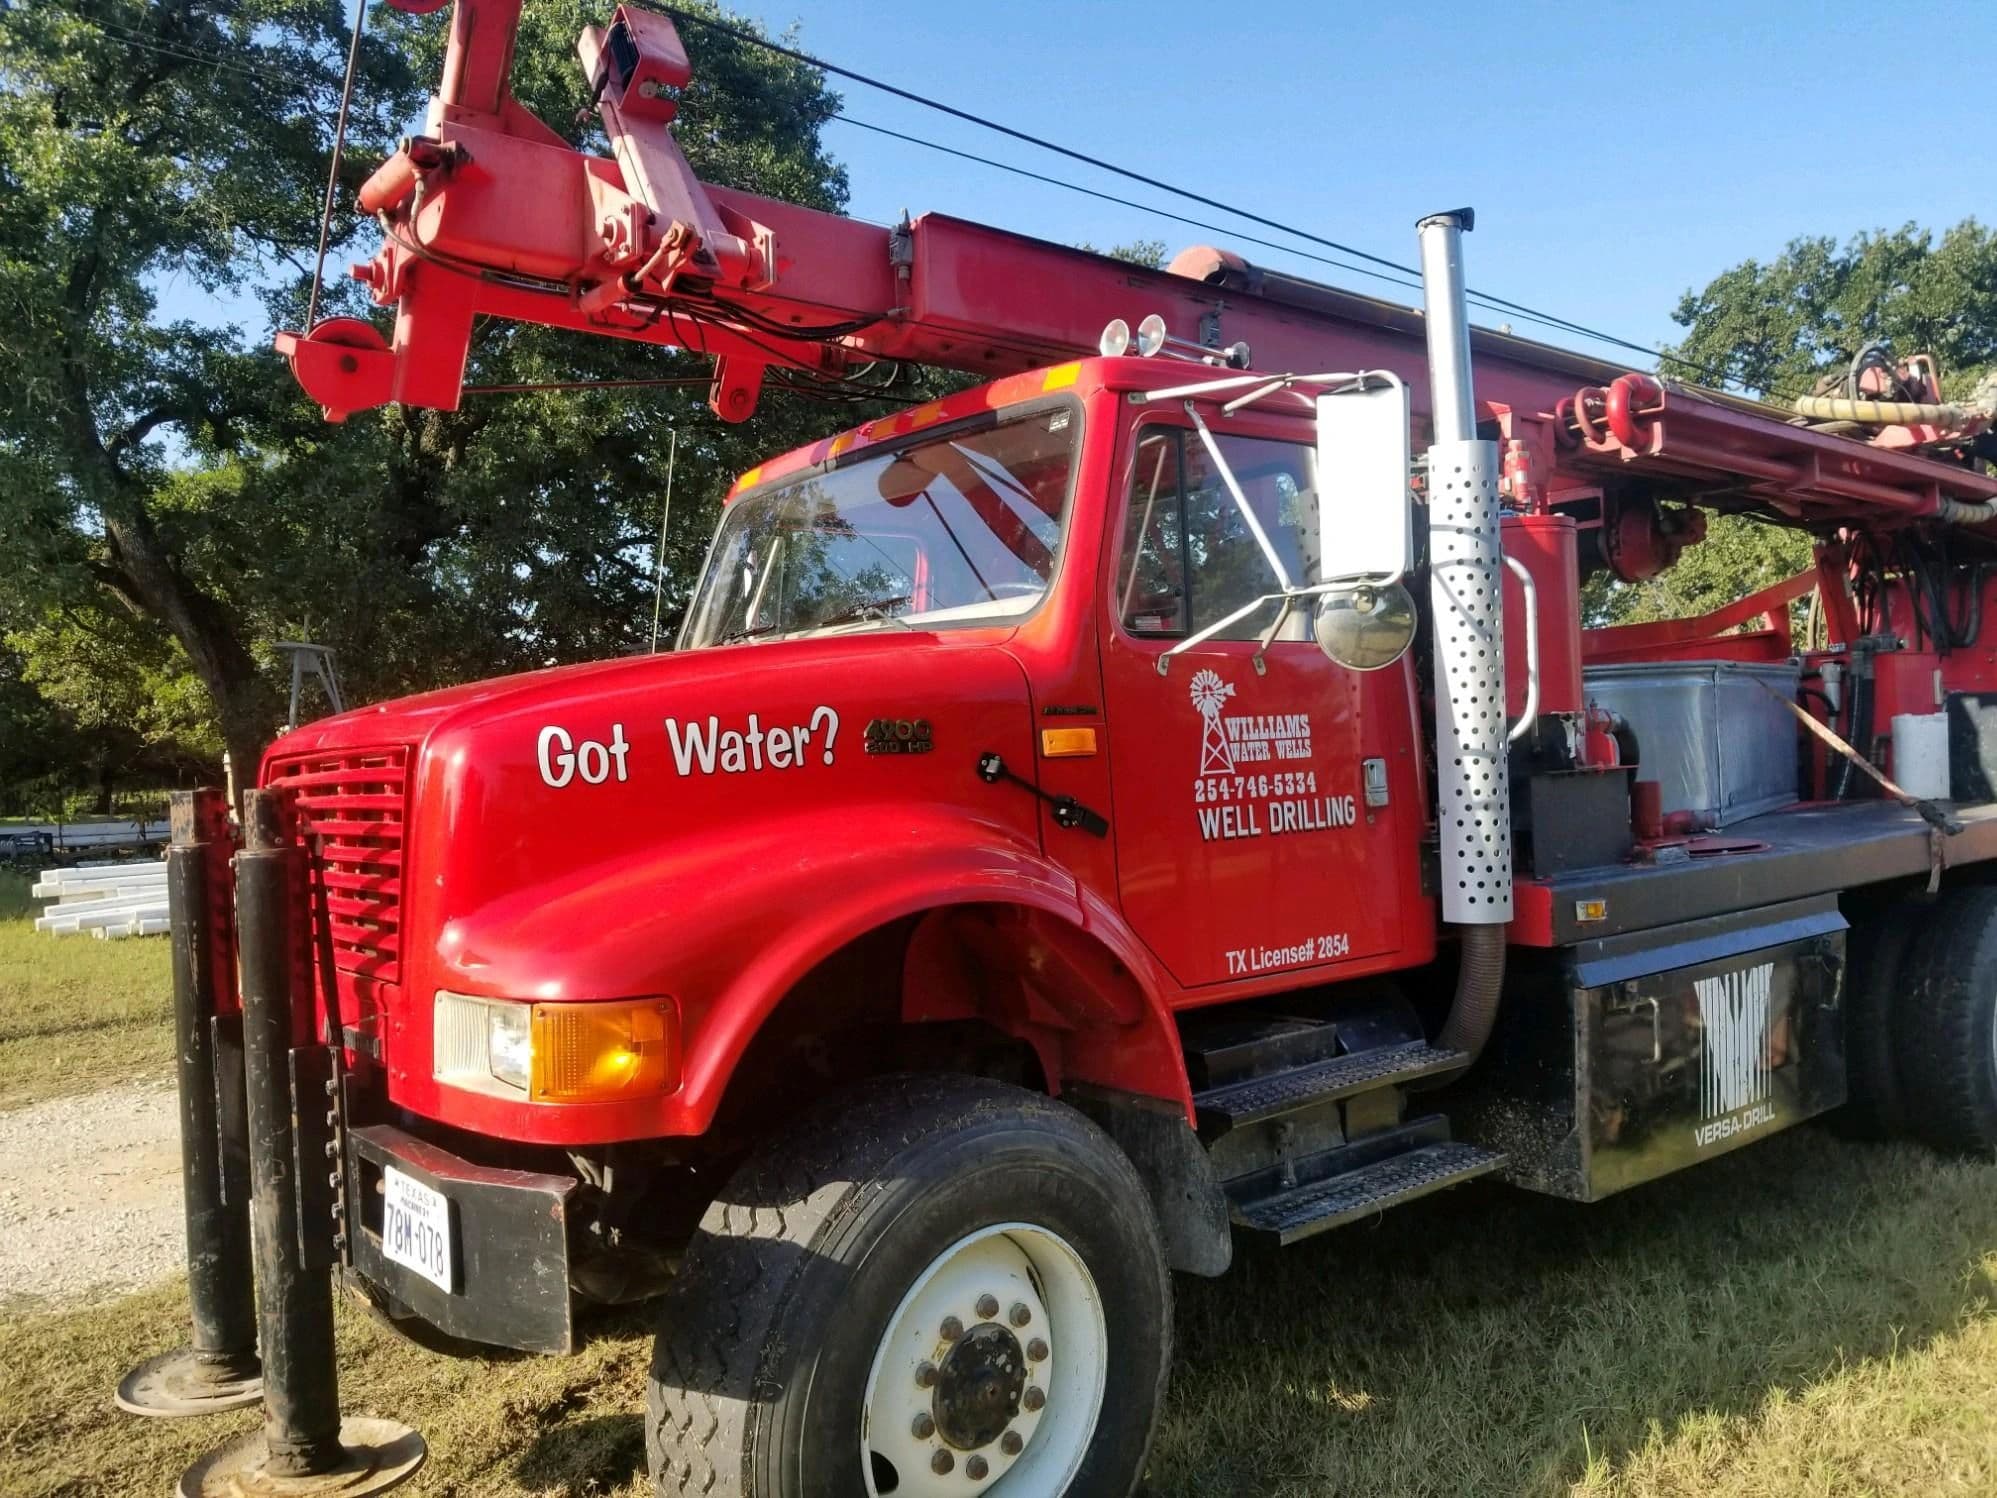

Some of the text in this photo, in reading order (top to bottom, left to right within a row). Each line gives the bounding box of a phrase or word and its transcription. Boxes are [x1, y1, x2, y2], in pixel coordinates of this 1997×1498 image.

[1225, 714, 1311, 741] WILLIAMS
[537, 705, 840, 788] Got Water?
[1230, 739, 1312, 762] WATER WELLS
[1195, 771, 1317, 802] 254-746-5334
[1199, 795, 1356, 841] WELL DRILLING
[1226, 933, 1349, 974] TX License# 2854
[1695, 1102, 1776, 1148] VERSA-DRILL
[400, 1180, 430, 1207] TEXAS
